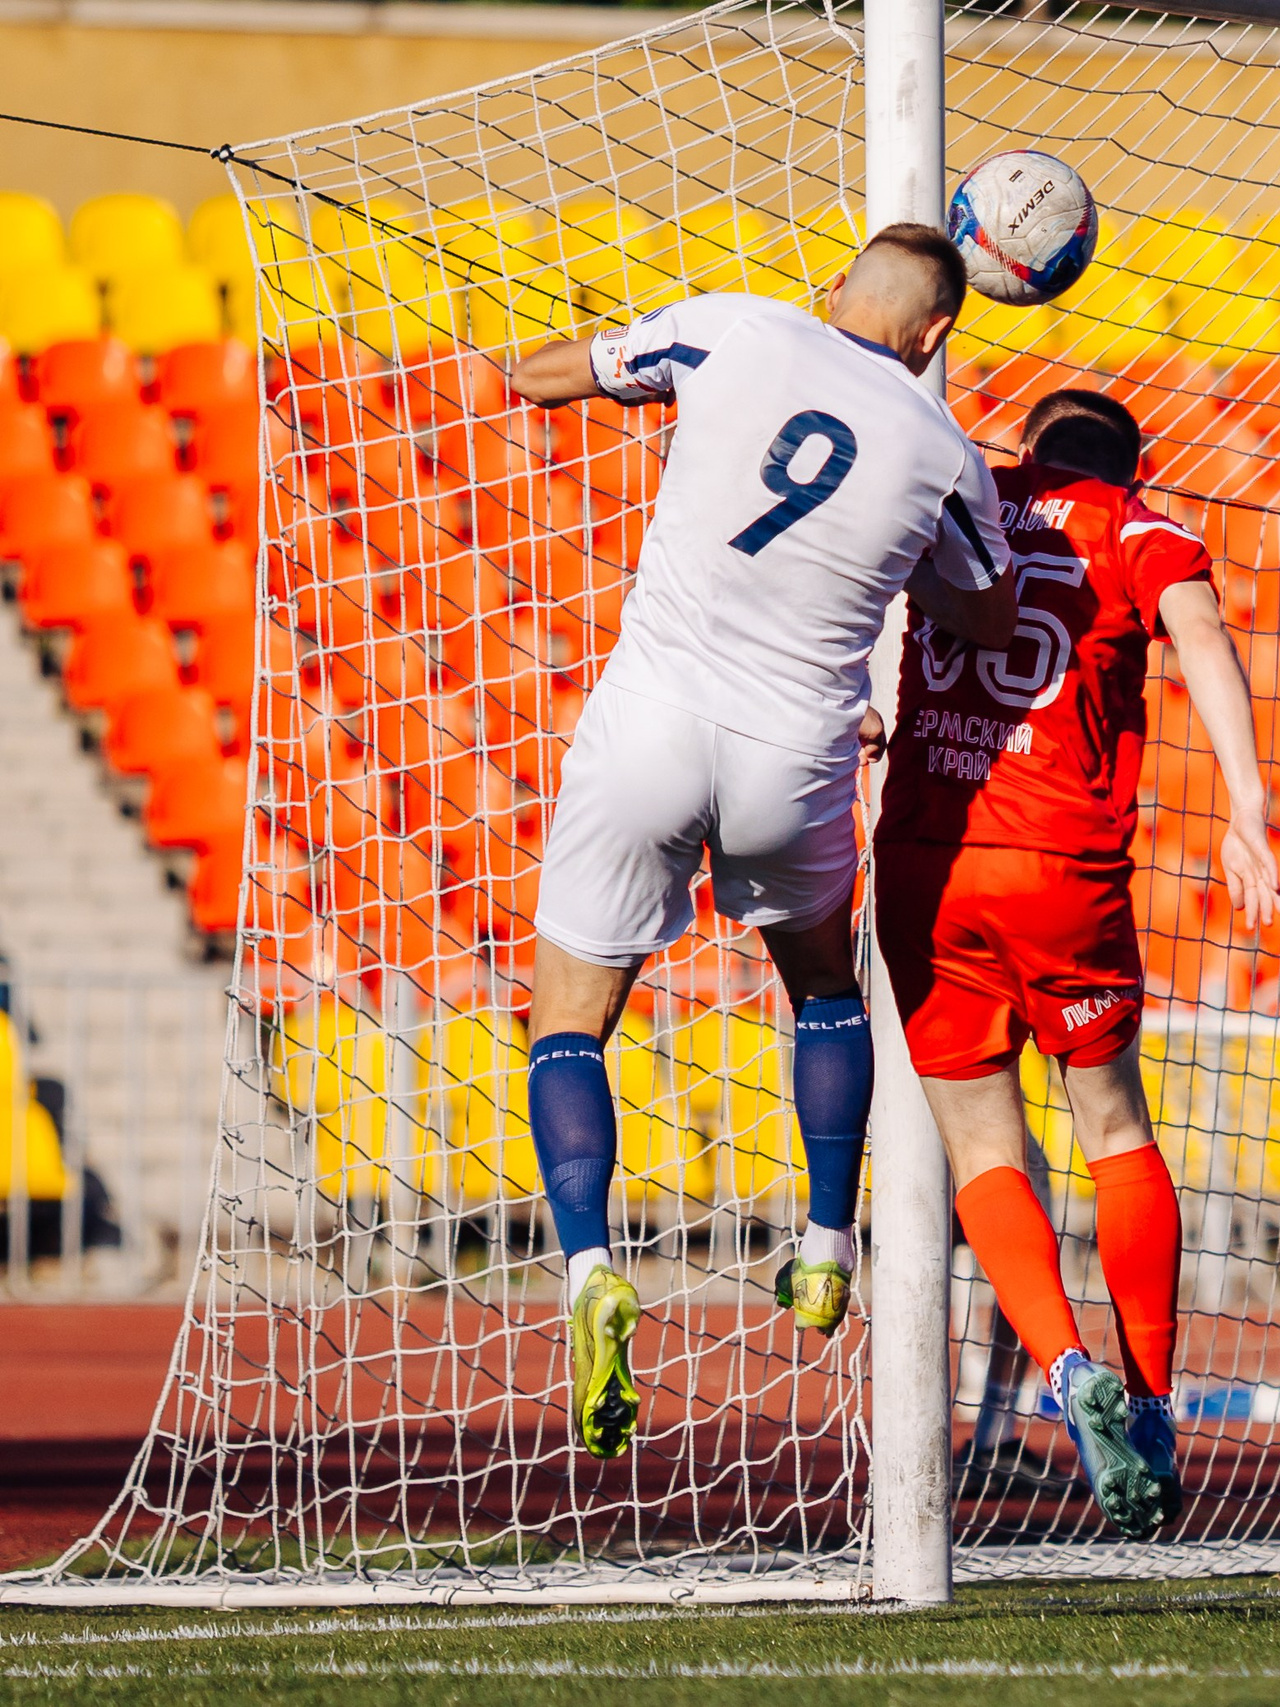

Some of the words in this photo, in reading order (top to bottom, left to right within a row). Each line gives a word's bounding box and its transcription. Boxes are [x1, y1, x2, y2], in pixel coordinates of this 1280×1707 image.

[1007, 180, 1056, 237] DEMIX
[727, 409, 858, 557] 9
[928, 745, 991, 781] КРАЙ
[796, 1015, 863, 1031] KELME
